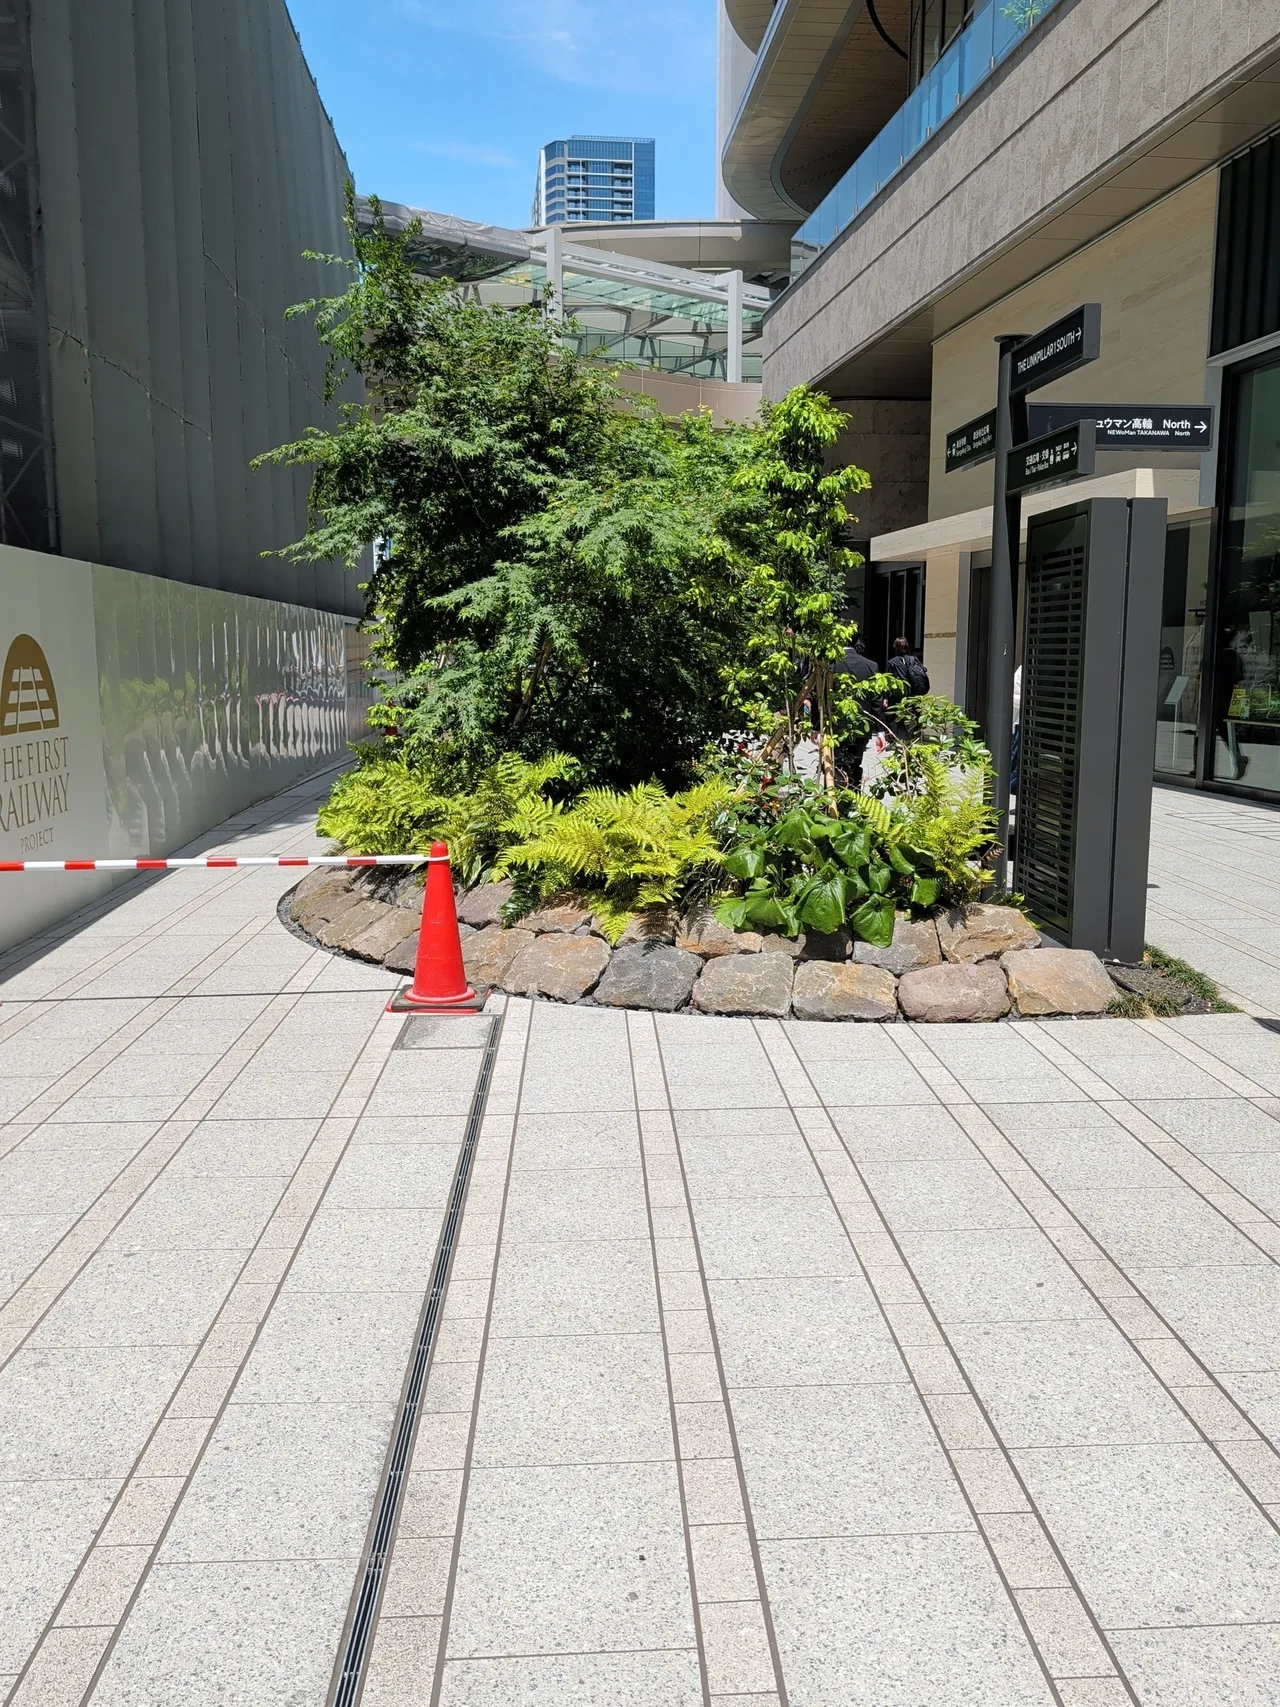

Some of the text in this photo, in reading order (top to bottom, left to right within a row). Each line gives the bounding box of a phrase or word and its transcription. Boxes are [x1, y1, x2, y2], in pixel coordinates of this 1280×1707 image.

[1017, 358, 1027, 374] THE
[1056, 330, 1075, 352] SOUTH
[1095, 418, 1191, 429] ュウマン高輪 North
[0, 736, 69, 783] HE FIRST
[20, 827, 54, 855] PROJECT
